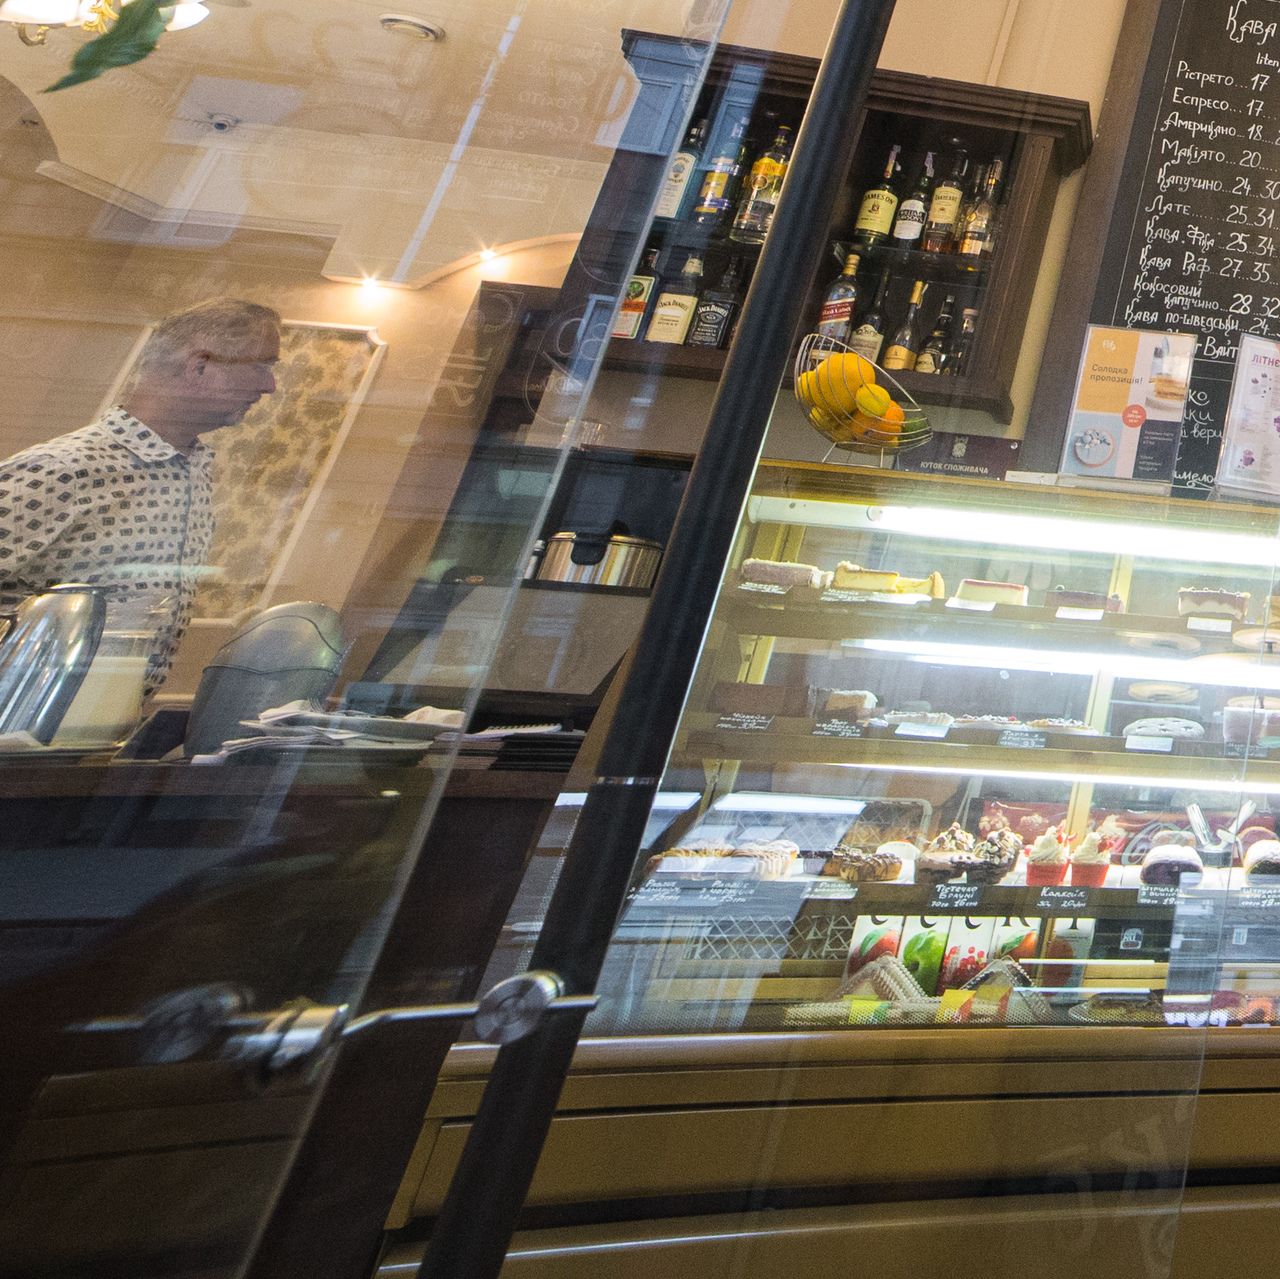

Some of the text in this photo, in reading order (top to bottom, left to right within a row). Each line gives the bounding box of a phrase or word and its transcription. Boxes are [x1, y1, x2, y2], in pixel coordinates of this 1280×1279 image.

[1250, 74, 1271, 92] 17
[1246, 99, 1265, 118] 17
[1248, 124, 1263, 142] 18
[1239, 151, 1262, 170] 20
[1232, 177, 1251, 196] 24
[1226, 205, 1248, 224] 25
[1257, 207, 1275, 228] 31
[1226, 233, 1248, 253] 25
[1257, 235, 1275, 257] 34
[1219, 258, 1243, 278] 27
[1250, 262, 1271, 283] 35
[1229, 293, 1253, 315] 28
[1259, 297, 1280, 318] 32
[1248, 318, 1270, 336] 24
